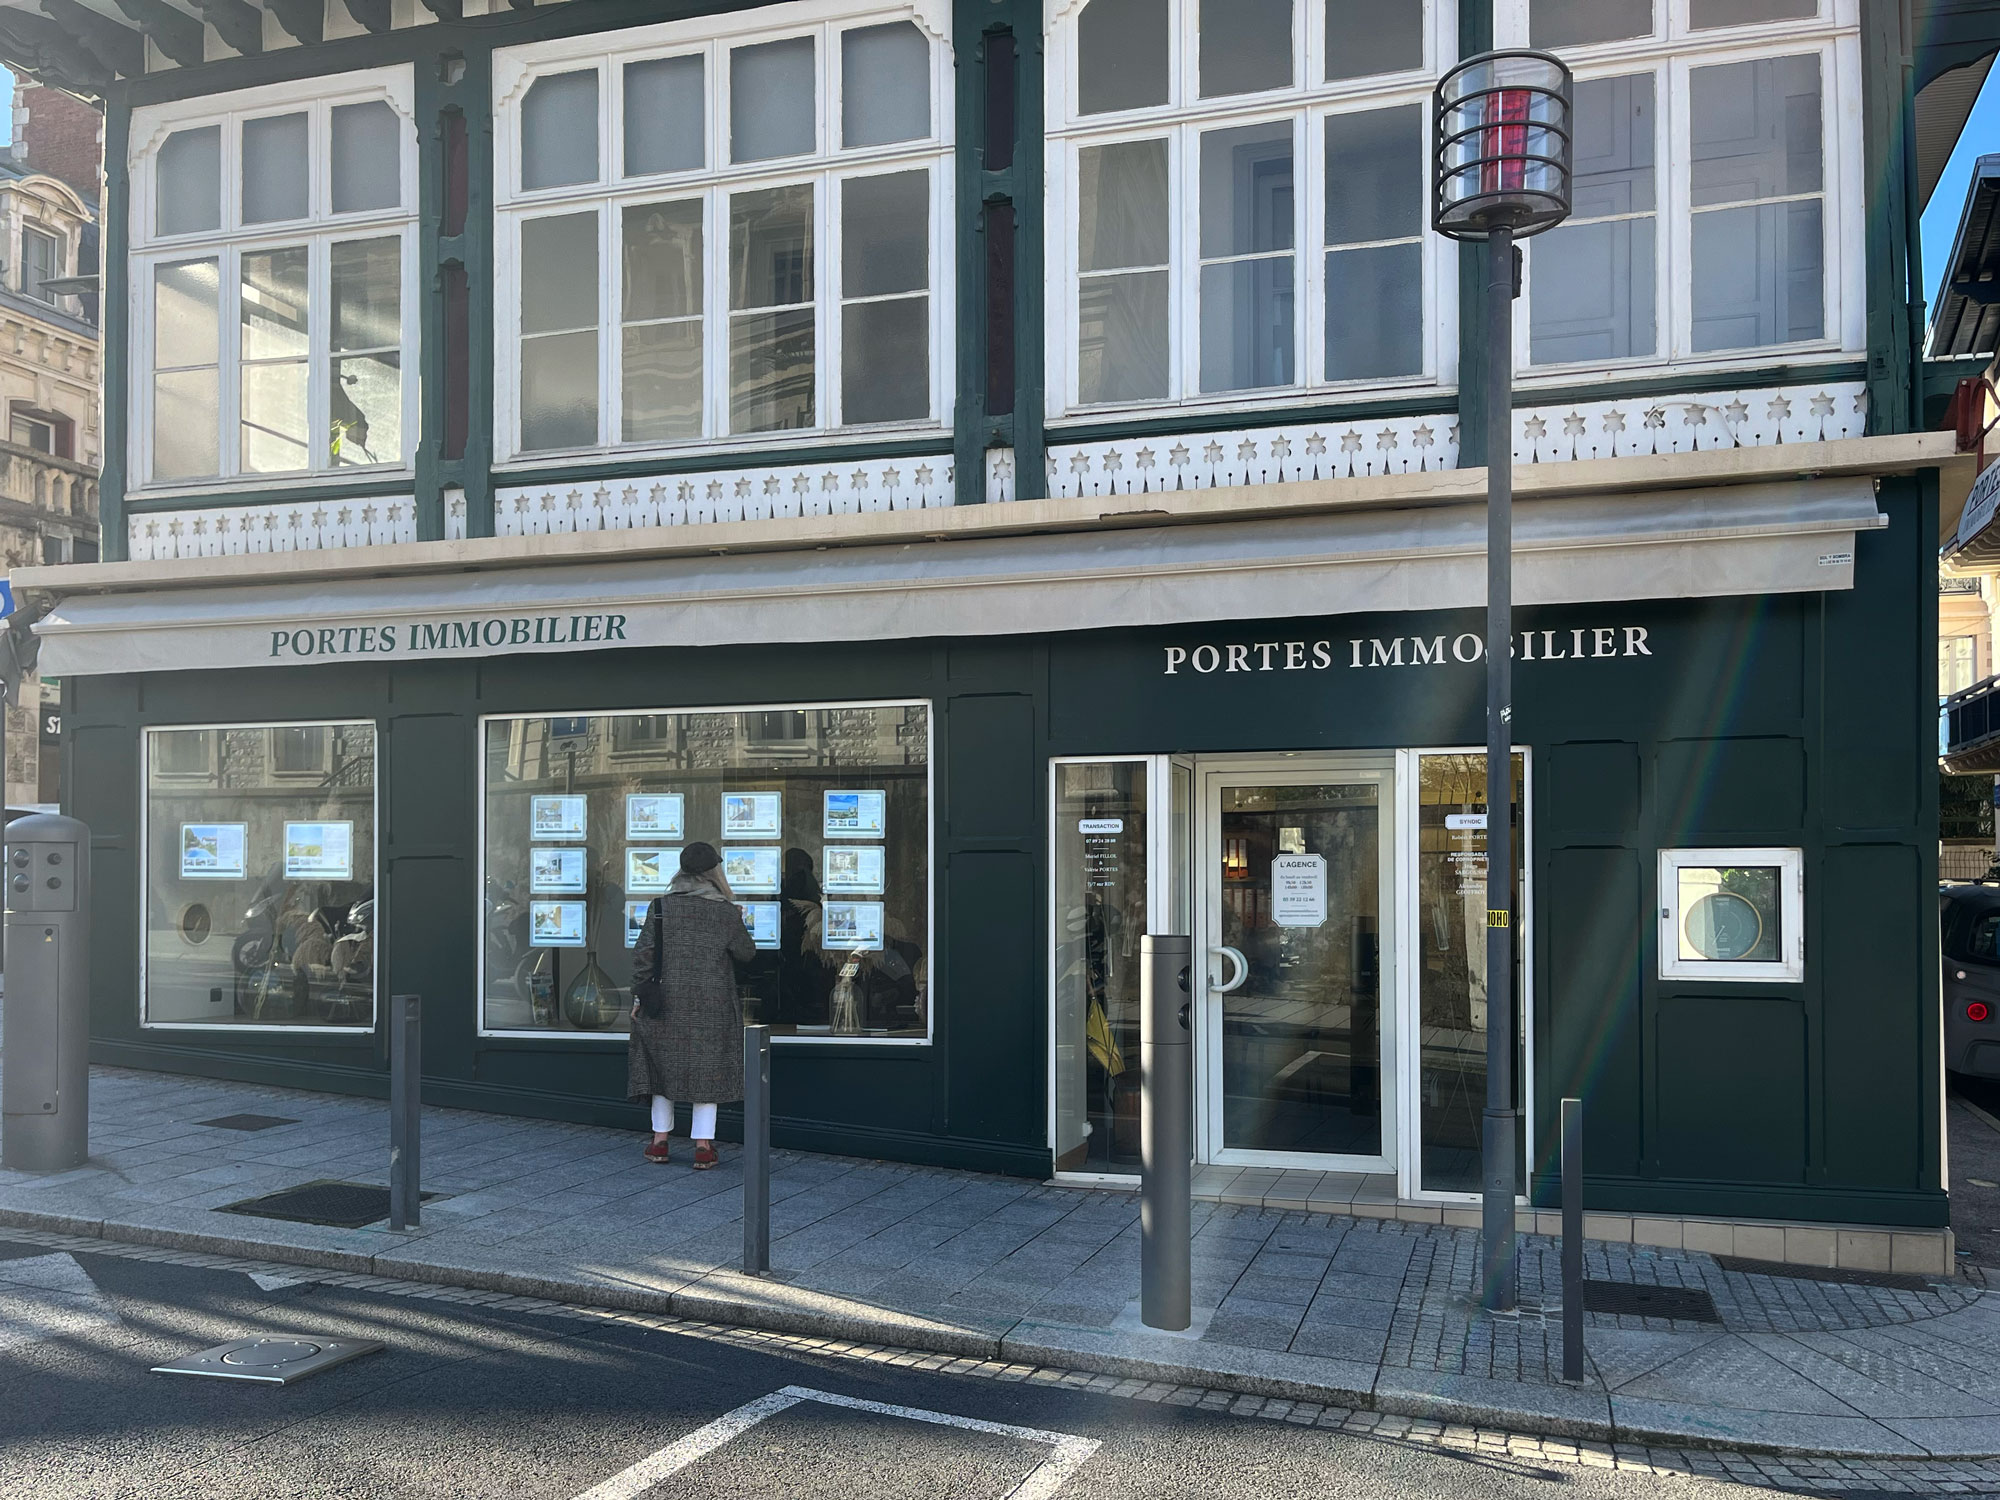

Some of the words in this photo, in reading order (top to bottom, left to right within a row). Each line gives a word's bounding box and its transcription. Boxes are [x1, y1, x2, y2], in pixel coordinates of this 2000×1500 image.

[269, 626, 396, 657] PORTES
[407, 614, 627, 651] IMMOBILIER
[1164, 640, 1332, 675] PORTES
[1349, 626, 1652, 668] IMMOILIER
